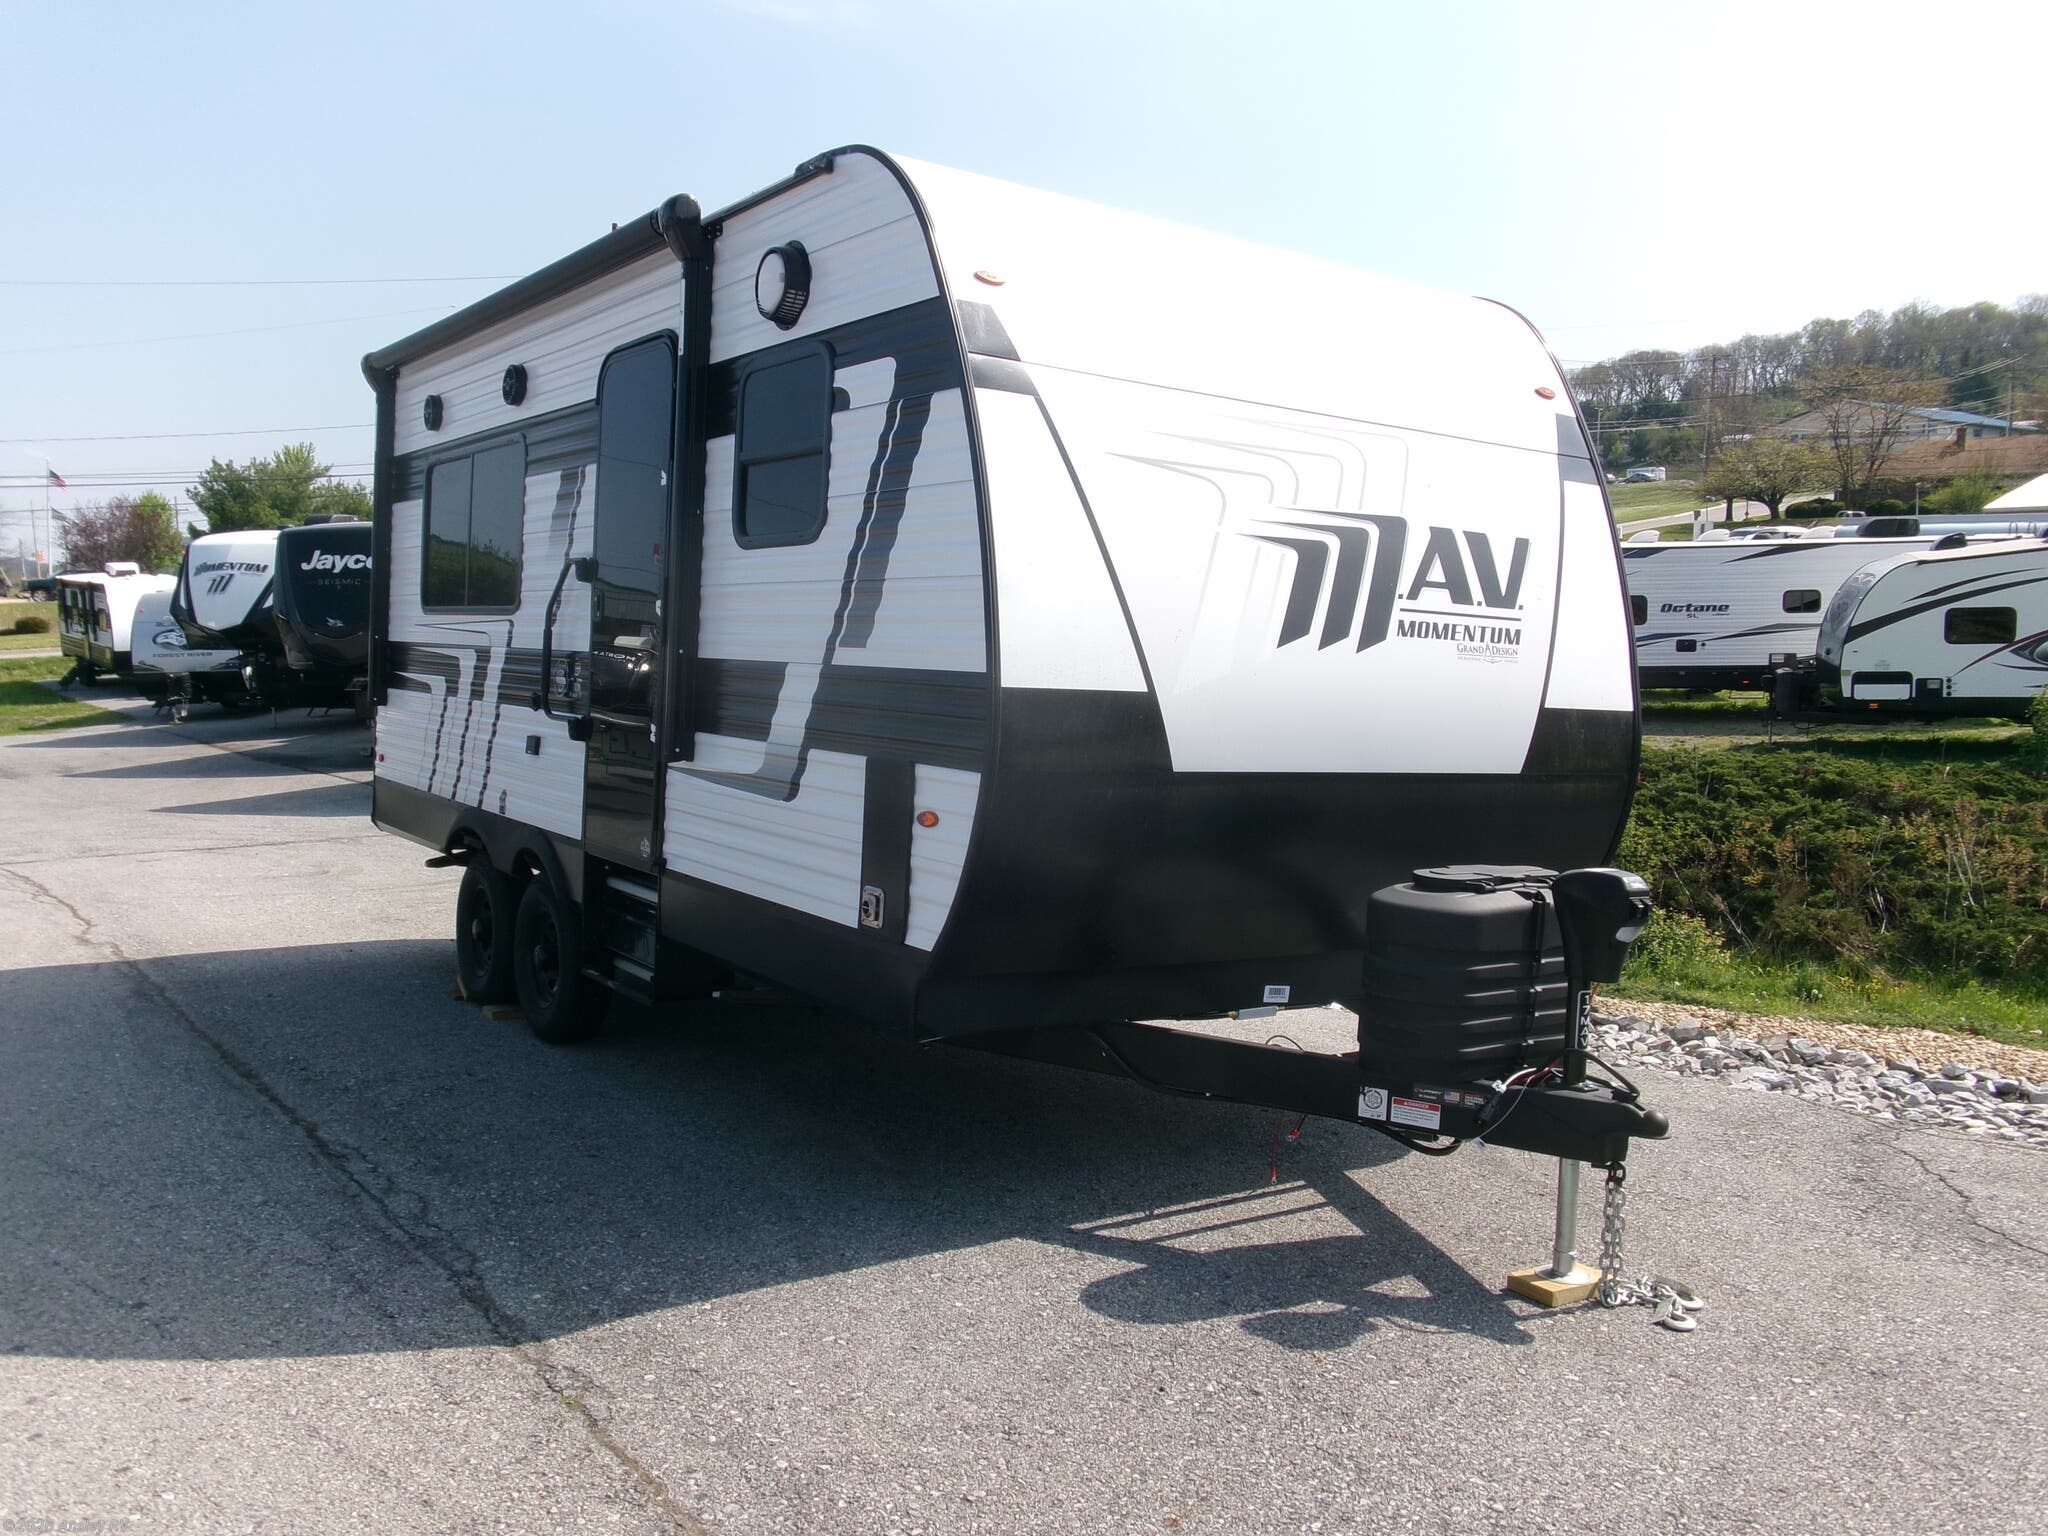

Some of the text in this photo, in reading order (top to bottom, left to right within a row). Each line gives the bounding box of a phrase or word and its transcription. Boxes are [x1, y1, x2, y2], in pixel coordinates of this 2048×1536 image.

[1660, 603, 1730, 613] Octane
[1396, 618, 1522, 646] MOMENTUM
[1580, 994, 1591, 1047] 17MAV
